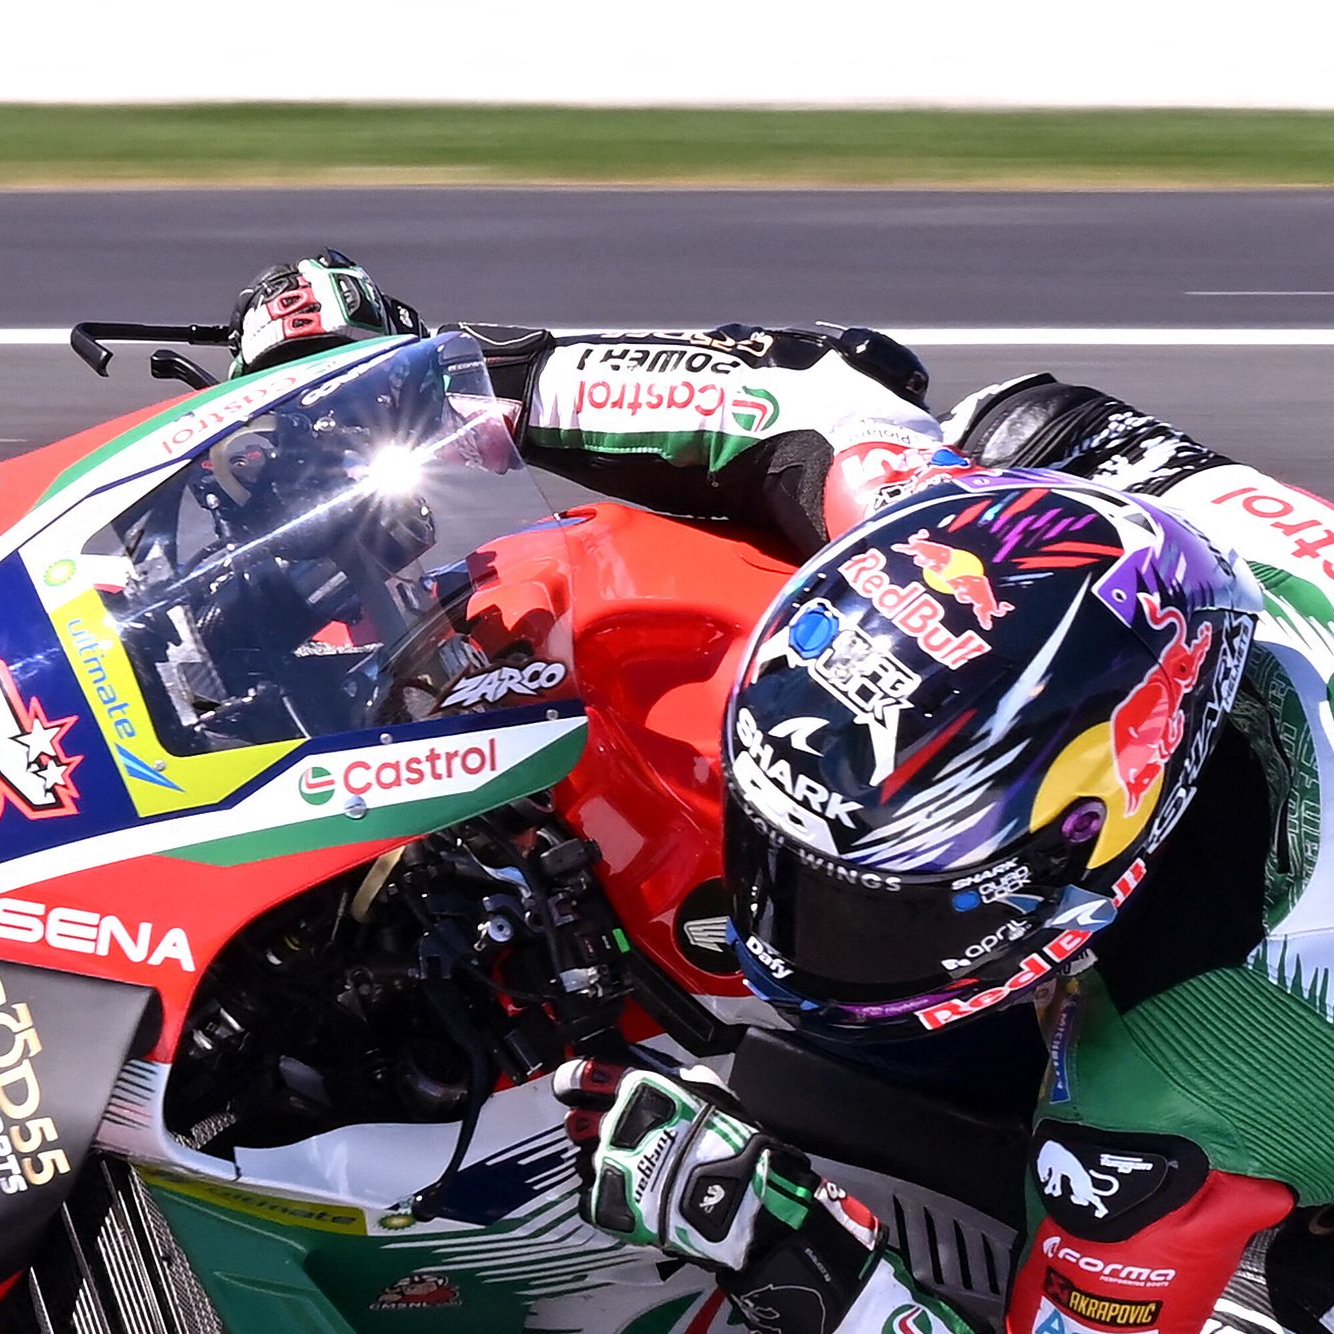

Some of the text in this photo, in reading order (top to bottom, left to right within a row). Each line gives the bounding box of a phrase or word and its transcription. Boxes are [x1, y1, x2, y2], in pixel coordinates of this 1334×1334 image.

[162, 375, 297, 455] Castrol
[575, 380, 725, 416] Castrol
[837, 548, 992, 671] Red Bull
[67, 617, 136, 740] ultimate
[440, 661, 567, 708] ZARCO
[343, 737, 498, 797] Castrol
[736, 707, 865, 830] SHARK
[798, 849, 902, 892] WINGS
[744, 935, 794, 979] Dafy
[914, 953, 1051, 1031] Red
